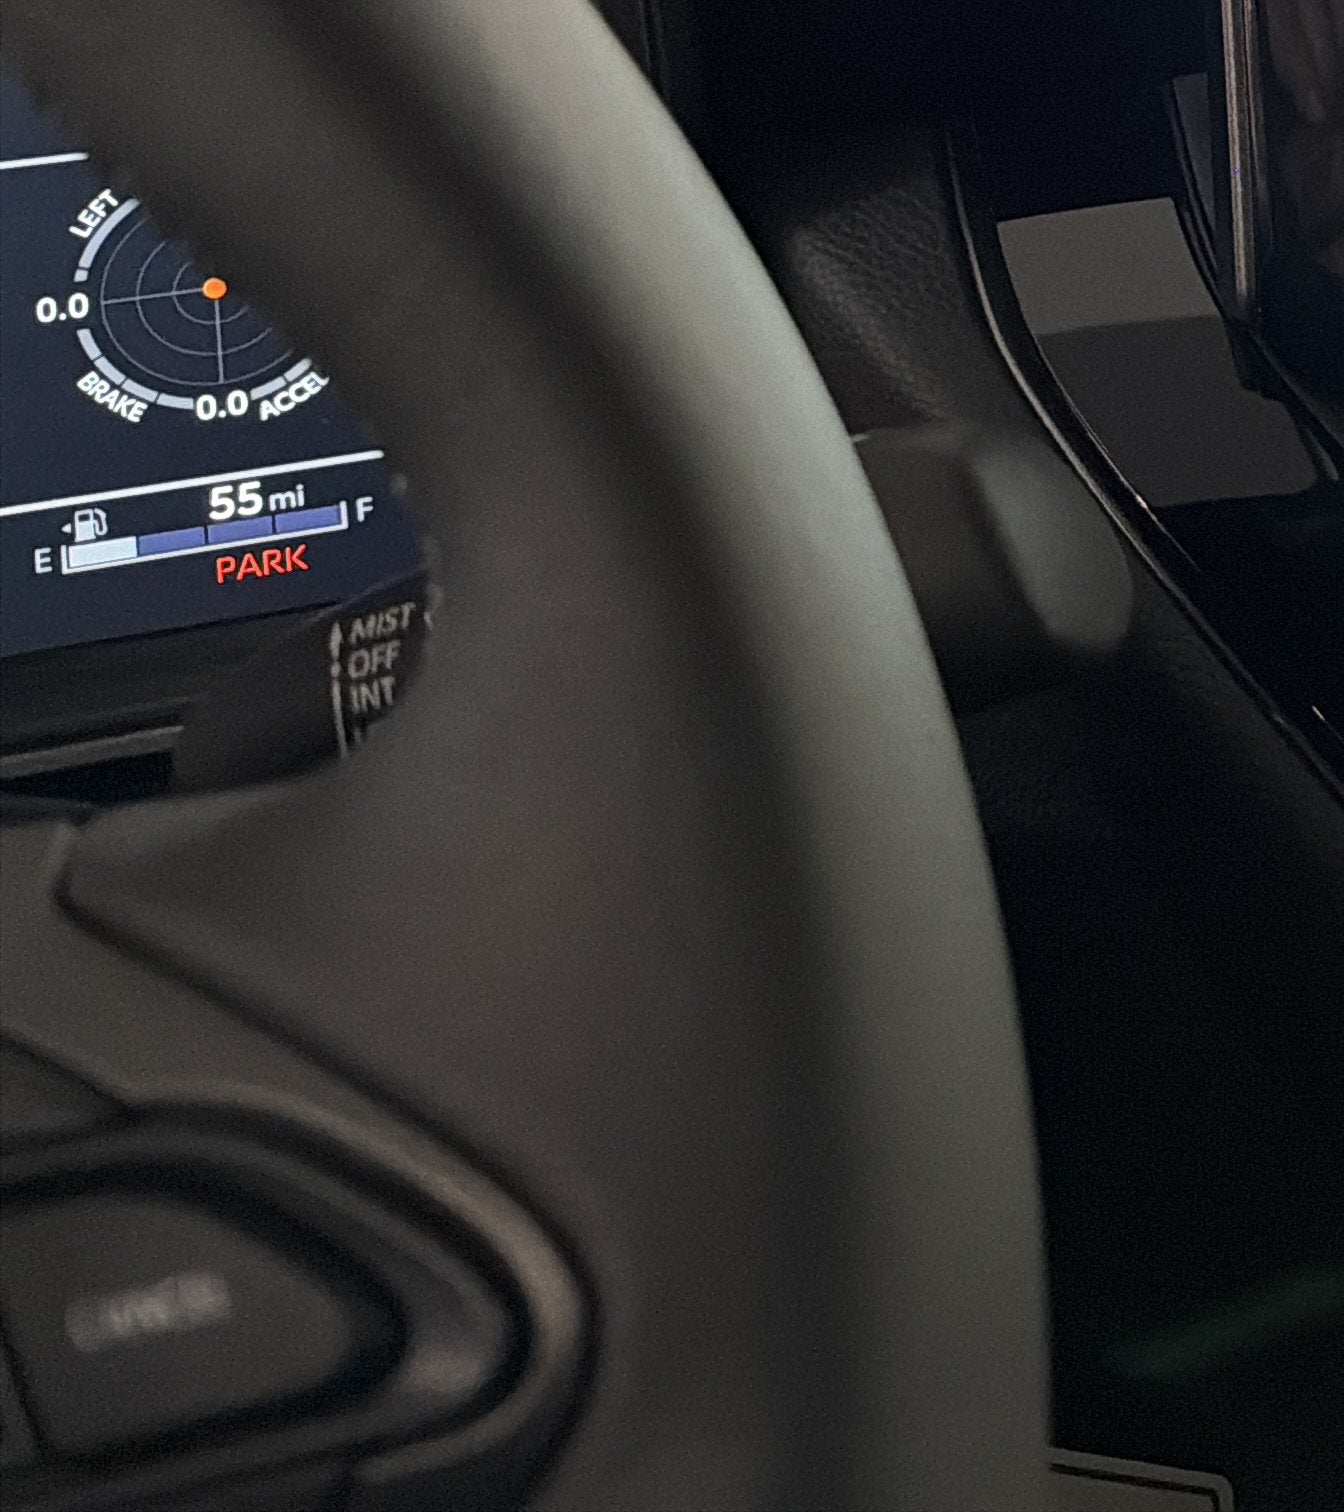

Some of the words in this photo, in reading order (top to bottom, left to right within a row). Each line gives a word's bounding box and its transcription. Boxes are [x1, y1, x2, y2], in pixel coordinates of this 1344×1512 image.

[68, 188, 120, 239] LEFT
[35, 292, 90, 324] 0.0
[76, 370, 150, 423] BRAKE
[195, 389, 249, 422] 0.0
[258, 372, 330, 422] ACCEL
[208, 481, 263, 521] 55
[268, 483, 306, 511] mi
[355, 496, 374, 522] F
[34, 548, 52, 574] E
[215, 544, 310, 584] PARK
[351, 601, 417, 645] MIST
[349, 640, 401, 679] OFF
[351, 676, 397, 714] INT
